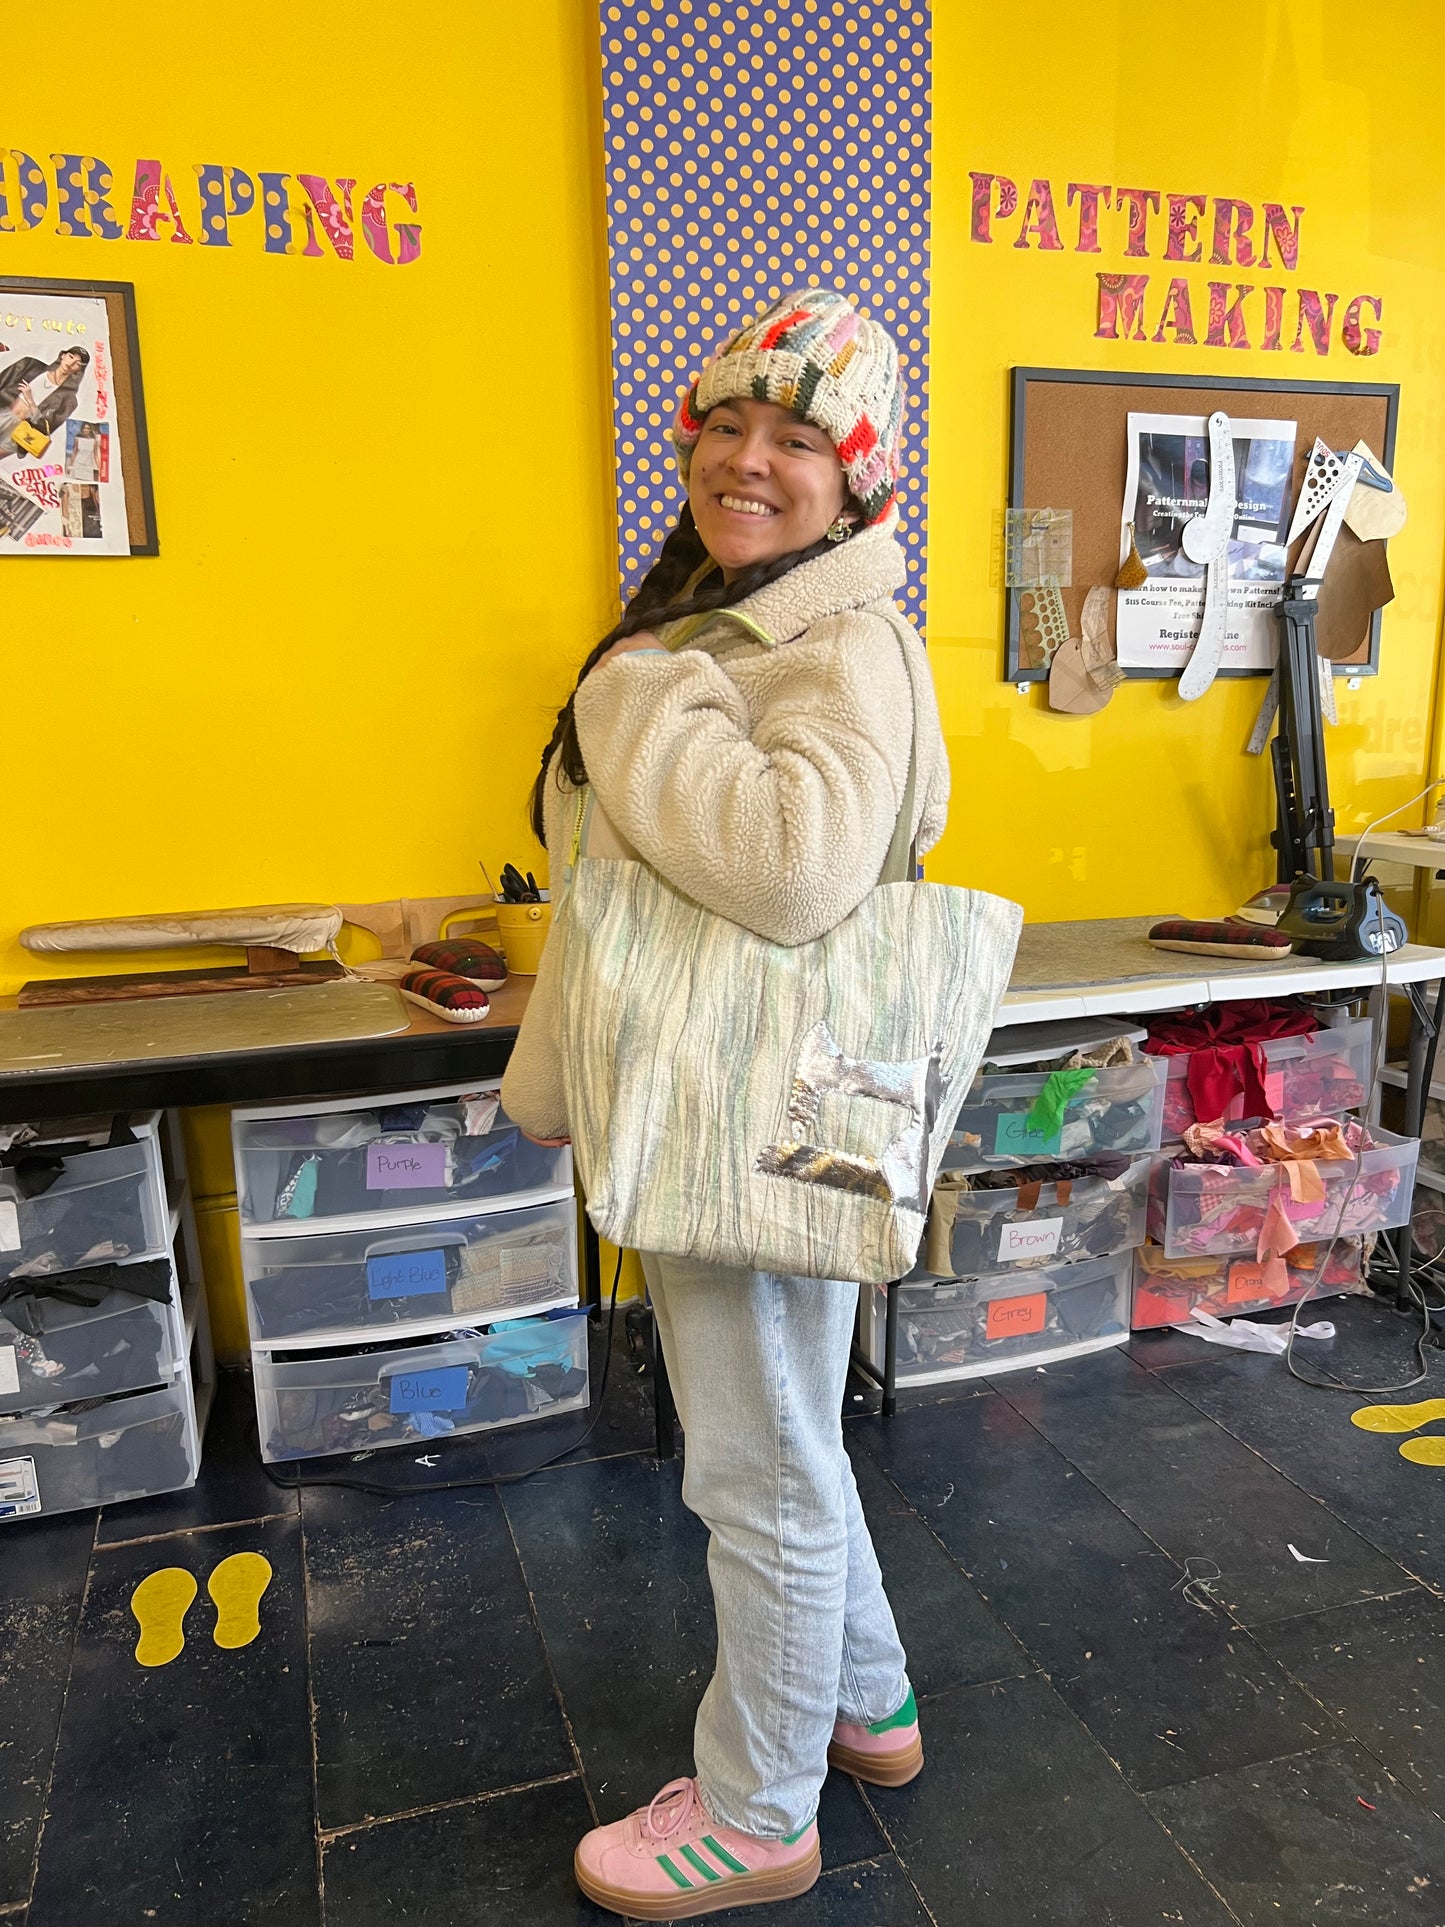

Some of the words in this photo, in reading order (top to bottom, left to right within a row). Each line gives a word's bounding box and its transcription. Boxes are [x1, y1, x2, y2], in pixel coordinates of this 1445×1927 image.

[0, 148, 422, 265] DRAPING
[967, 171, 1306, 271] PATTERN
[1093, 271, 1384, 358] MAKING
[1316, 441, 1330, 458] SOUL
[1146, 494, 1208, 508] Patternma
[1150, 584, 1168, 592] how
[1179, 585, 1203, 593] make
[1243, 586, 1280, 595] Patterns!
[1125, 598, 1140, 606] $115
[1141, 598, 1168, 606] Course
[1168, 599, 1184, 608] Fee,
[1245, 600, 1257, 608] Kit
[1159, 628, 1200, 641] Registe
[1006, 1121, 1045, 1140] Gree
[376, 1155, 422, 1173] Purple
[1009, 1229, 1056, 1249] Brown
[409, 1265, 440, 1284] Blue
[992, 1305, 1033, 1323] Grey
[400, 1380, 441, 1400] Blue
